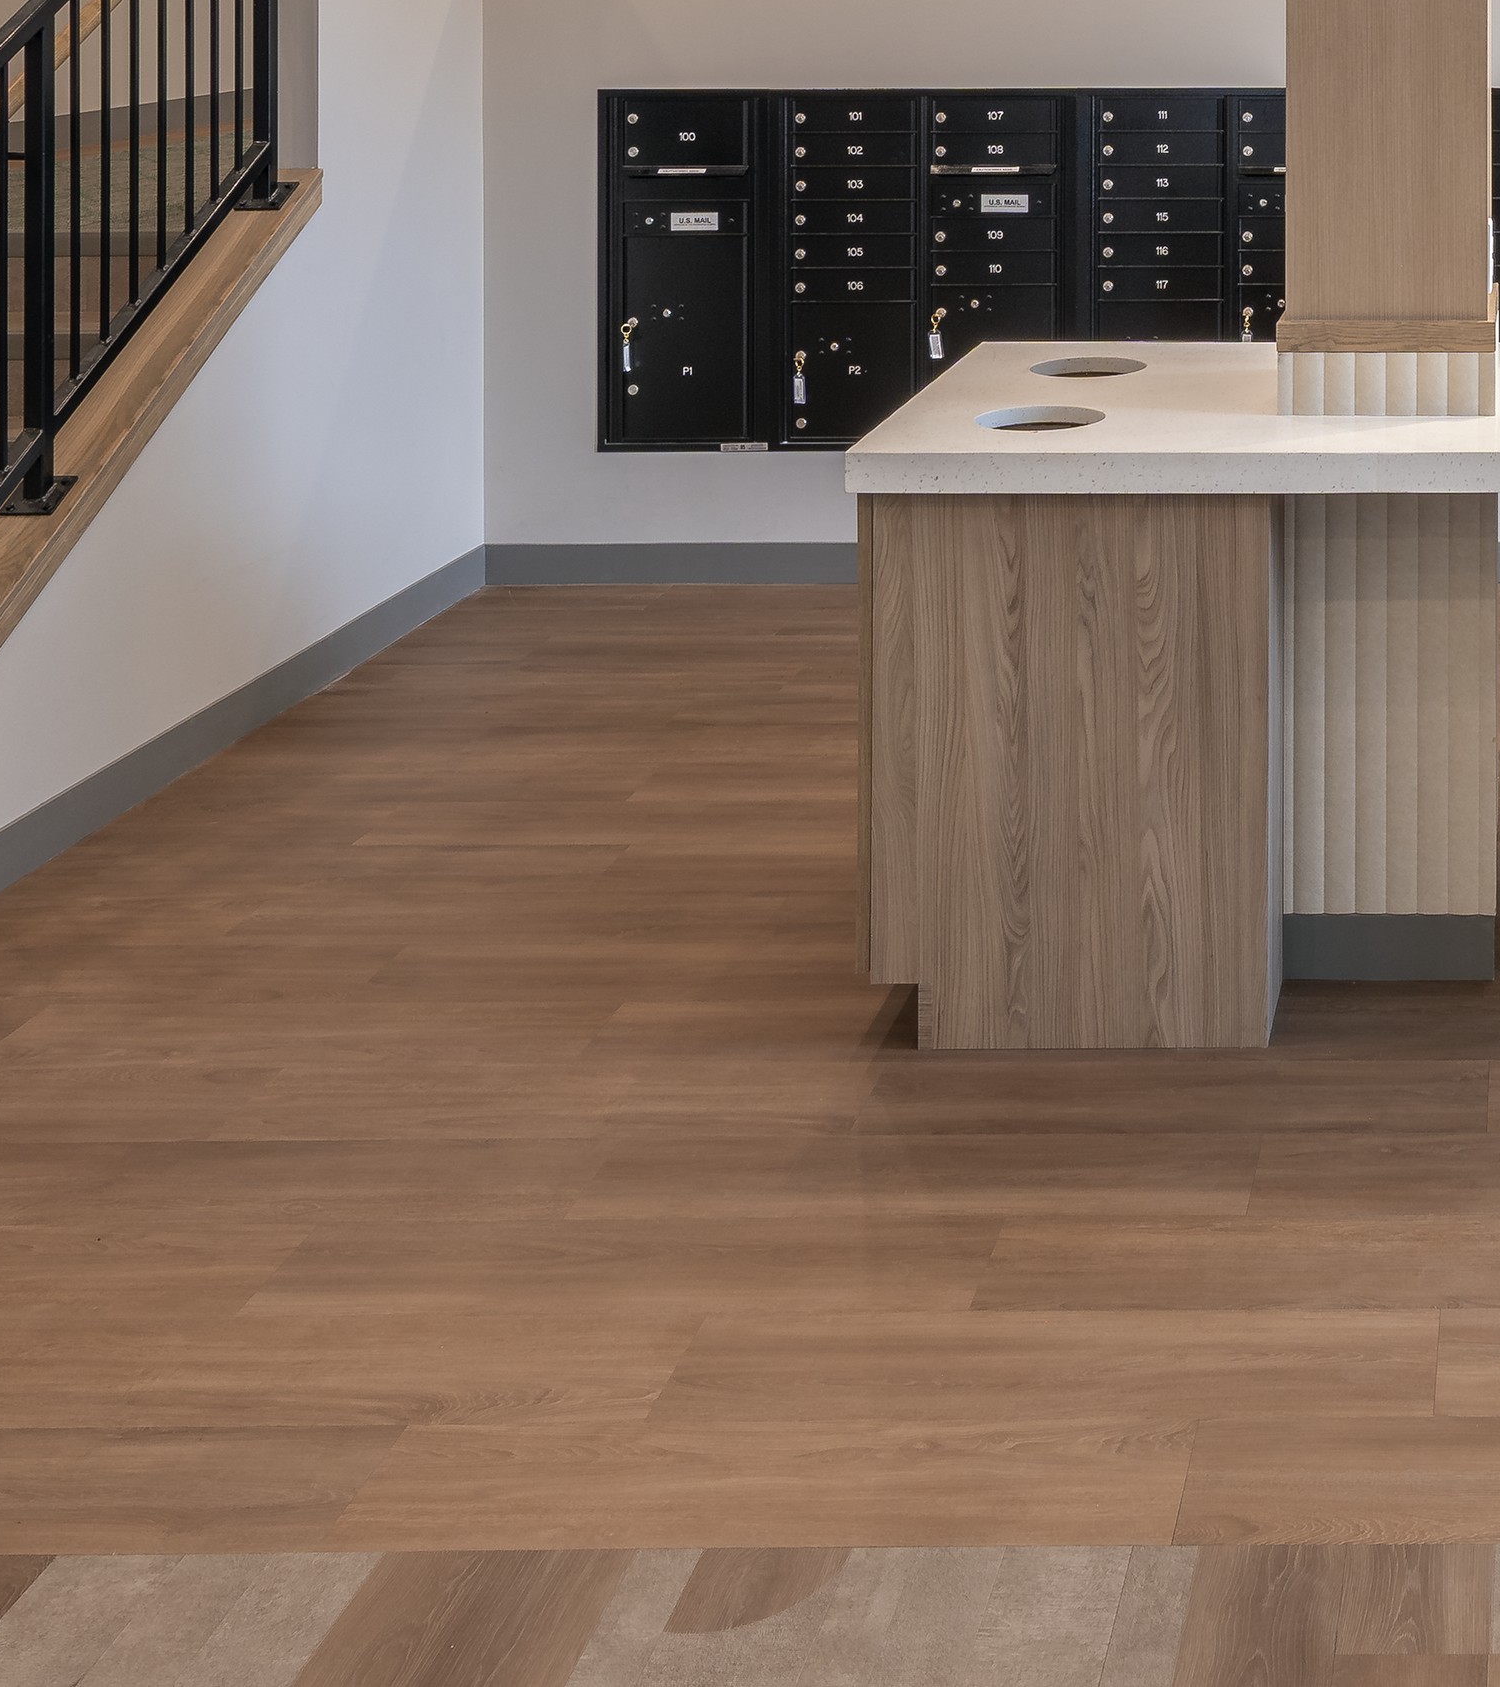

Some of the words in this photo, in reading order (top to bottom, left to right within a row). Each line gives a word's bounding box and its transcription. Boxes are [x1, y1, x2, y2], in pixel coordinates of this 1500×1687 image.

[848, 111, 863, 121] 101
[987, 110, 1005, 121] 107
[1157, 110, 1168, 120] 111
[678, 131, 697, 142] 100
[846, 145, 864, 156] 102
[987, 144, 1004, 155] 108
[1156, 143, 1170, 154] 112
[847, 179, 864, 190] 103
[1155, 177, 1170, 188] 113
[846, 213, 864, 223] 104
[1155, 211, 1169, 222] 115
[986, 230, 1004, 240] 109
[846, 247, 864, 257] 105
[1155, 245, 1169, 256] 116
[988, 263, 1003, 274] 110
[847, 280, 864, 291] 106
[1155, 279, 1169, 290] 117
[682, 366, 693, 376] P1
[848, 365, 862, 375] P2
